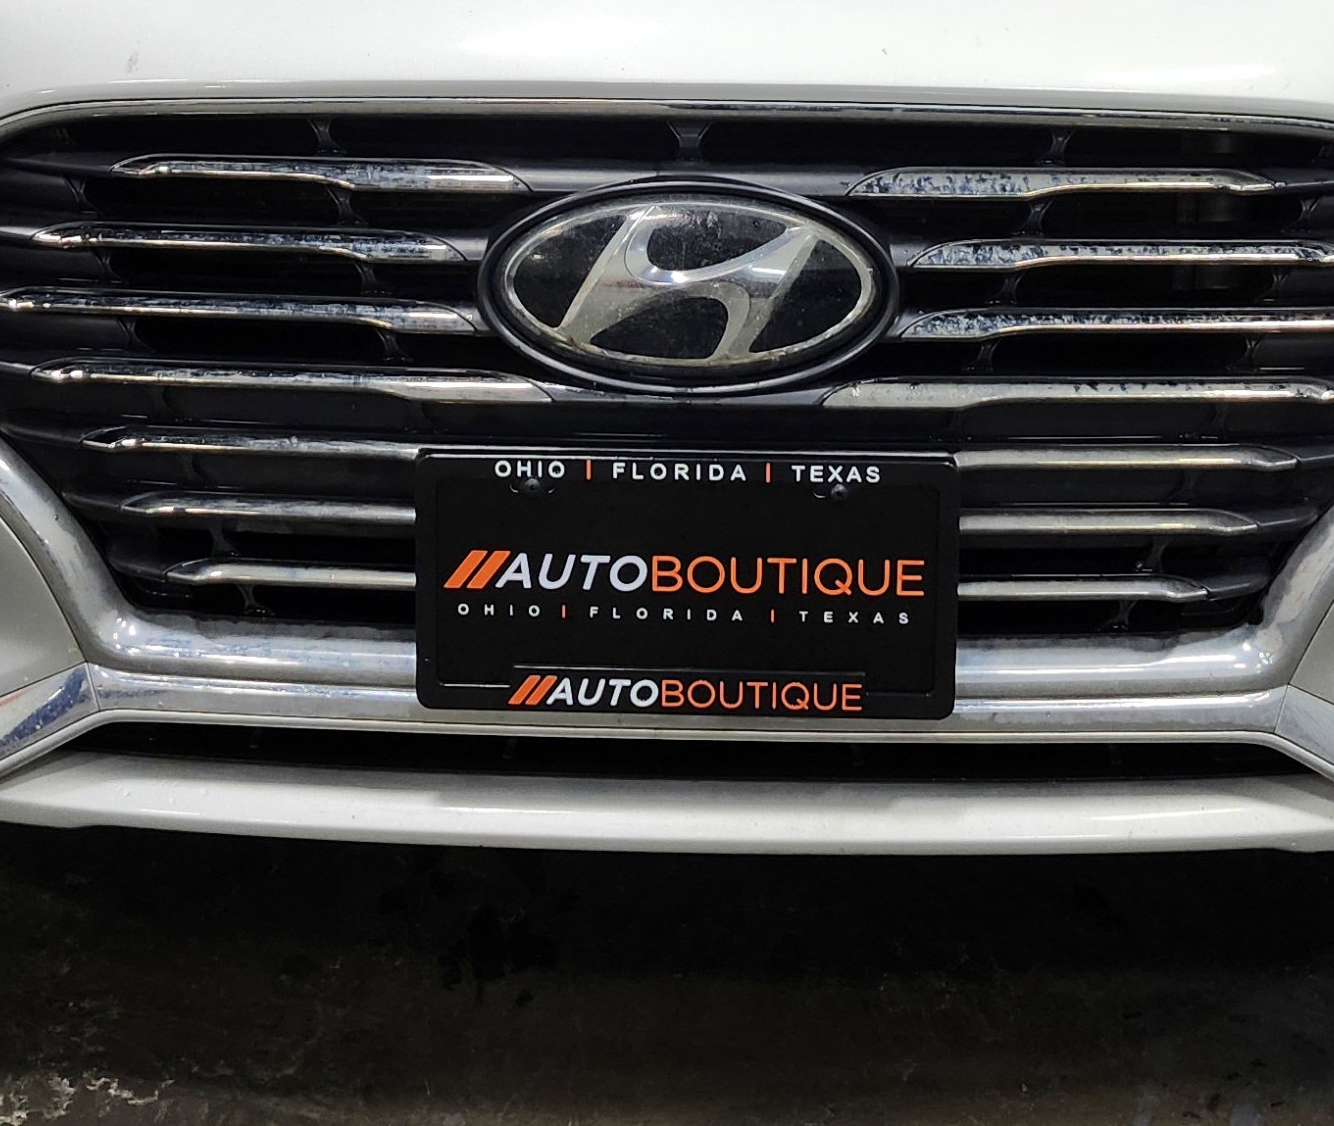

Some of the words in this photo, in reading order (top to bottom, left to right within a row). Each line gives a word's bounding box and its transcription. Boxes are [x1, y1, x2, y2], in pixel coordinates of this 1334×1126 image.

[494, 459, 566, 479] OHIO
[612, 462, 748, 482] FLORIDA
[791, 464, 881, 483] TEXAS
[495, 552, 925, 597] AUTOBOUTIQUE
[457, 603, 541, 618] OHIO
[589, 606, 744, 622] FLORIDA
[798, 610, 910, 625] TEXAS
[545, 676, 863, 712] AUTOBOUTIQUE
